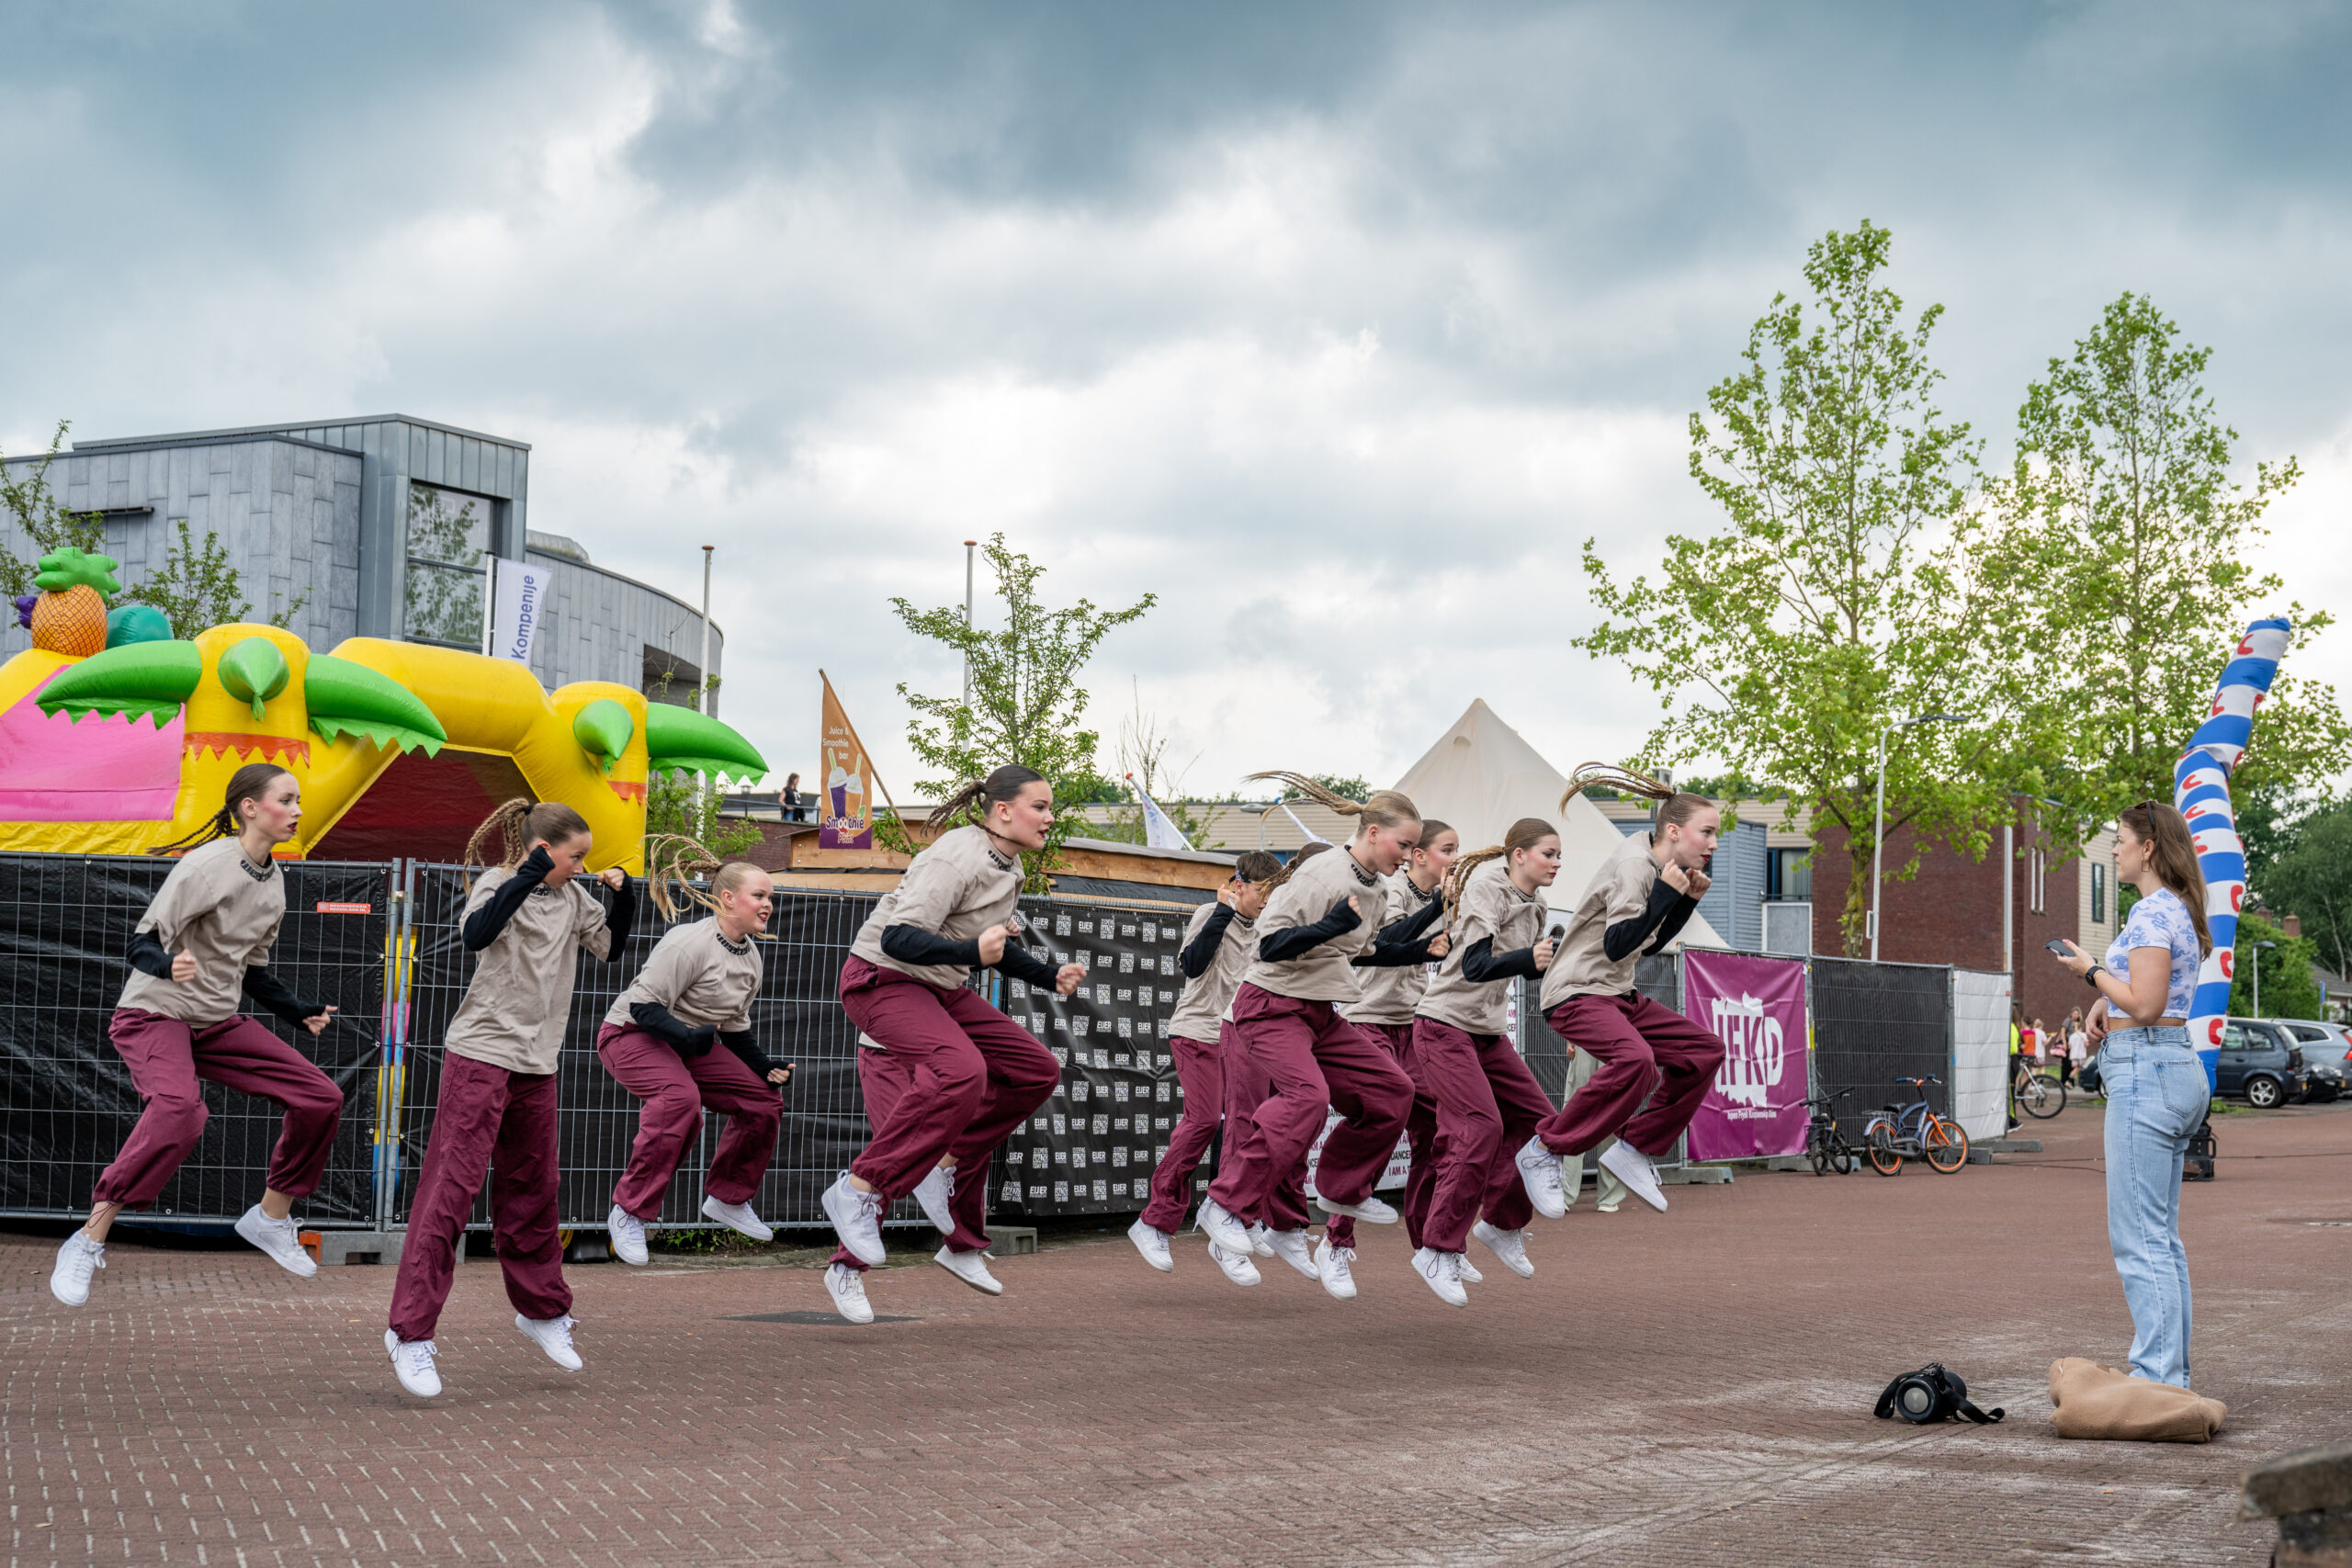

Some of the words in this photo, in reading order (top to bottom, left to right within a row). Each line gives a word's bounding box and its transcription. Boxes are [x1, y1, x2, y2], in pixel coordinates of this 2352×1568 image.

[511, 575, 537, 660] Kompenije
[829, 726, 844, 735] Juice
[823, 738, 849, 748] Smoothie
[839, 750, 849, 760] bar
[826, 815, 865, 829] Smoothie
